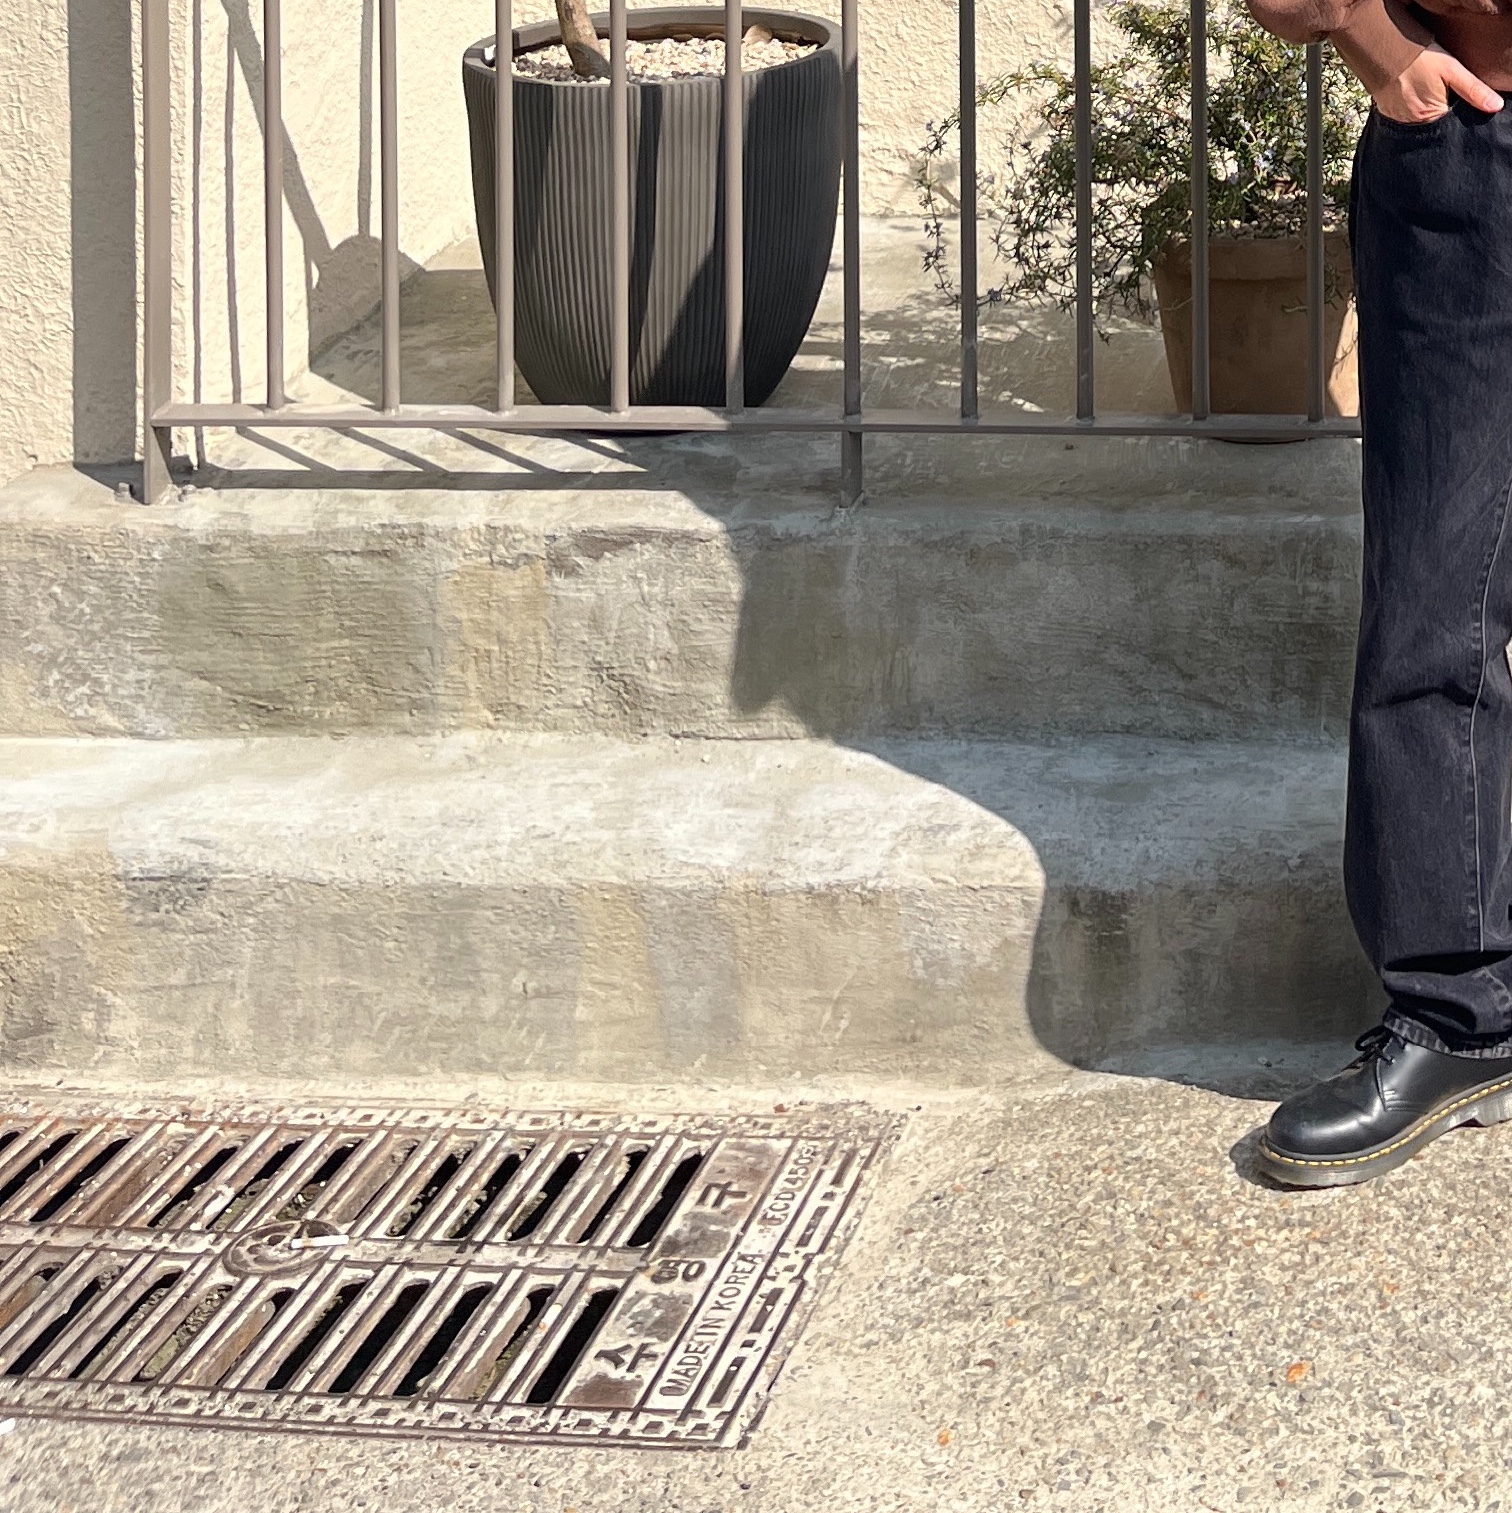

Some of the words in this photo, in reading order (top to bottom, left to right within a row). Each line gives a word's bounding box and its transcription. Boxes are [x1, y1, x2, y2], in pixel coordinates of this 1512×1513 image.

[710, 1251, 766, 1311] KOREA
[694, 1316, 727, 1337] IN
[658, 1341, 711, 1397] MADE
